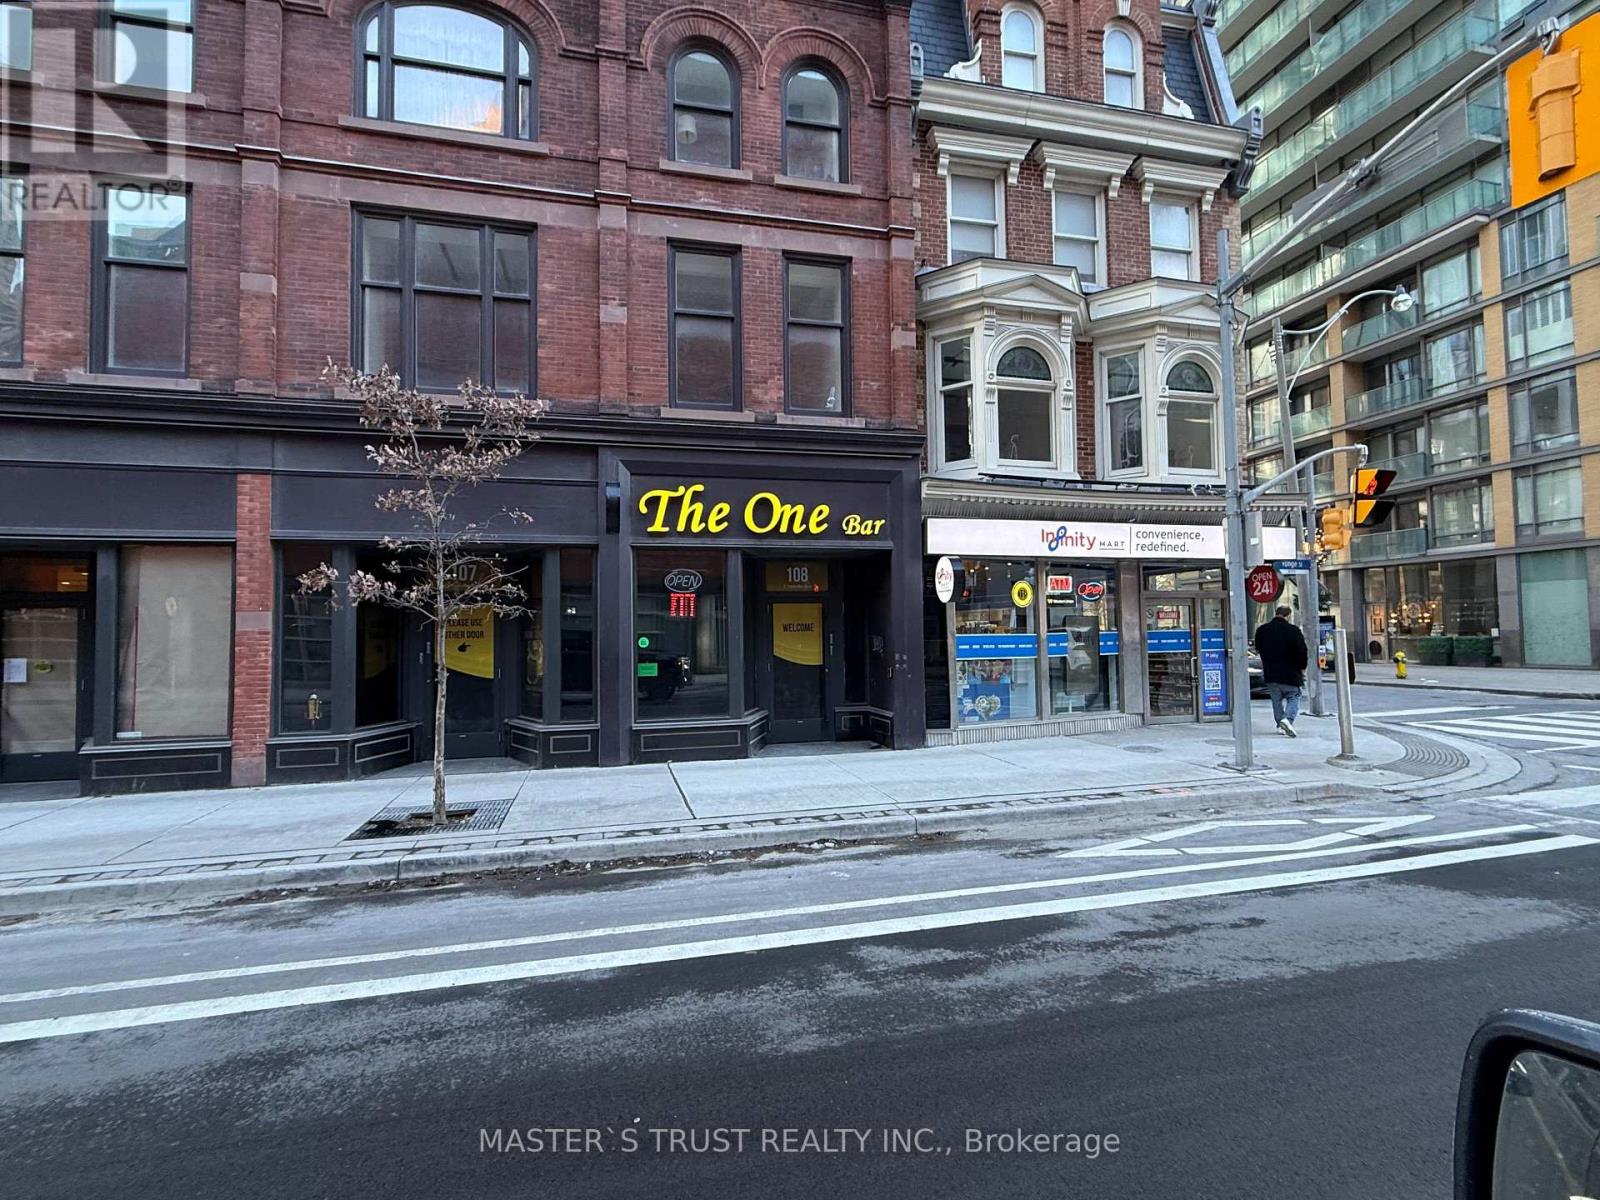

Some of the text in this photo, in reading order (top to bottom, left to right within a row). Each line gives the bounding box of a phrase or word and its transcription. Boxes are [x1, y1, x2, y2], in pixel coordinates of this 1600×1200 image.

[639, 484, 885, 535] The One Bar
[1135, 529, 1205, 542] convenience,
[1099, 540, 1125, 548] MART
[1135, 541, 1190, 553] redefined.
[787, 567, 809, 582] 108
[1252, 572, 1272, 581] OPEN
[667, 575, 699, 587] OPEN
[1049, 578, 1071, 590] ATM
[783, 623, 815, 632] WELCOME
